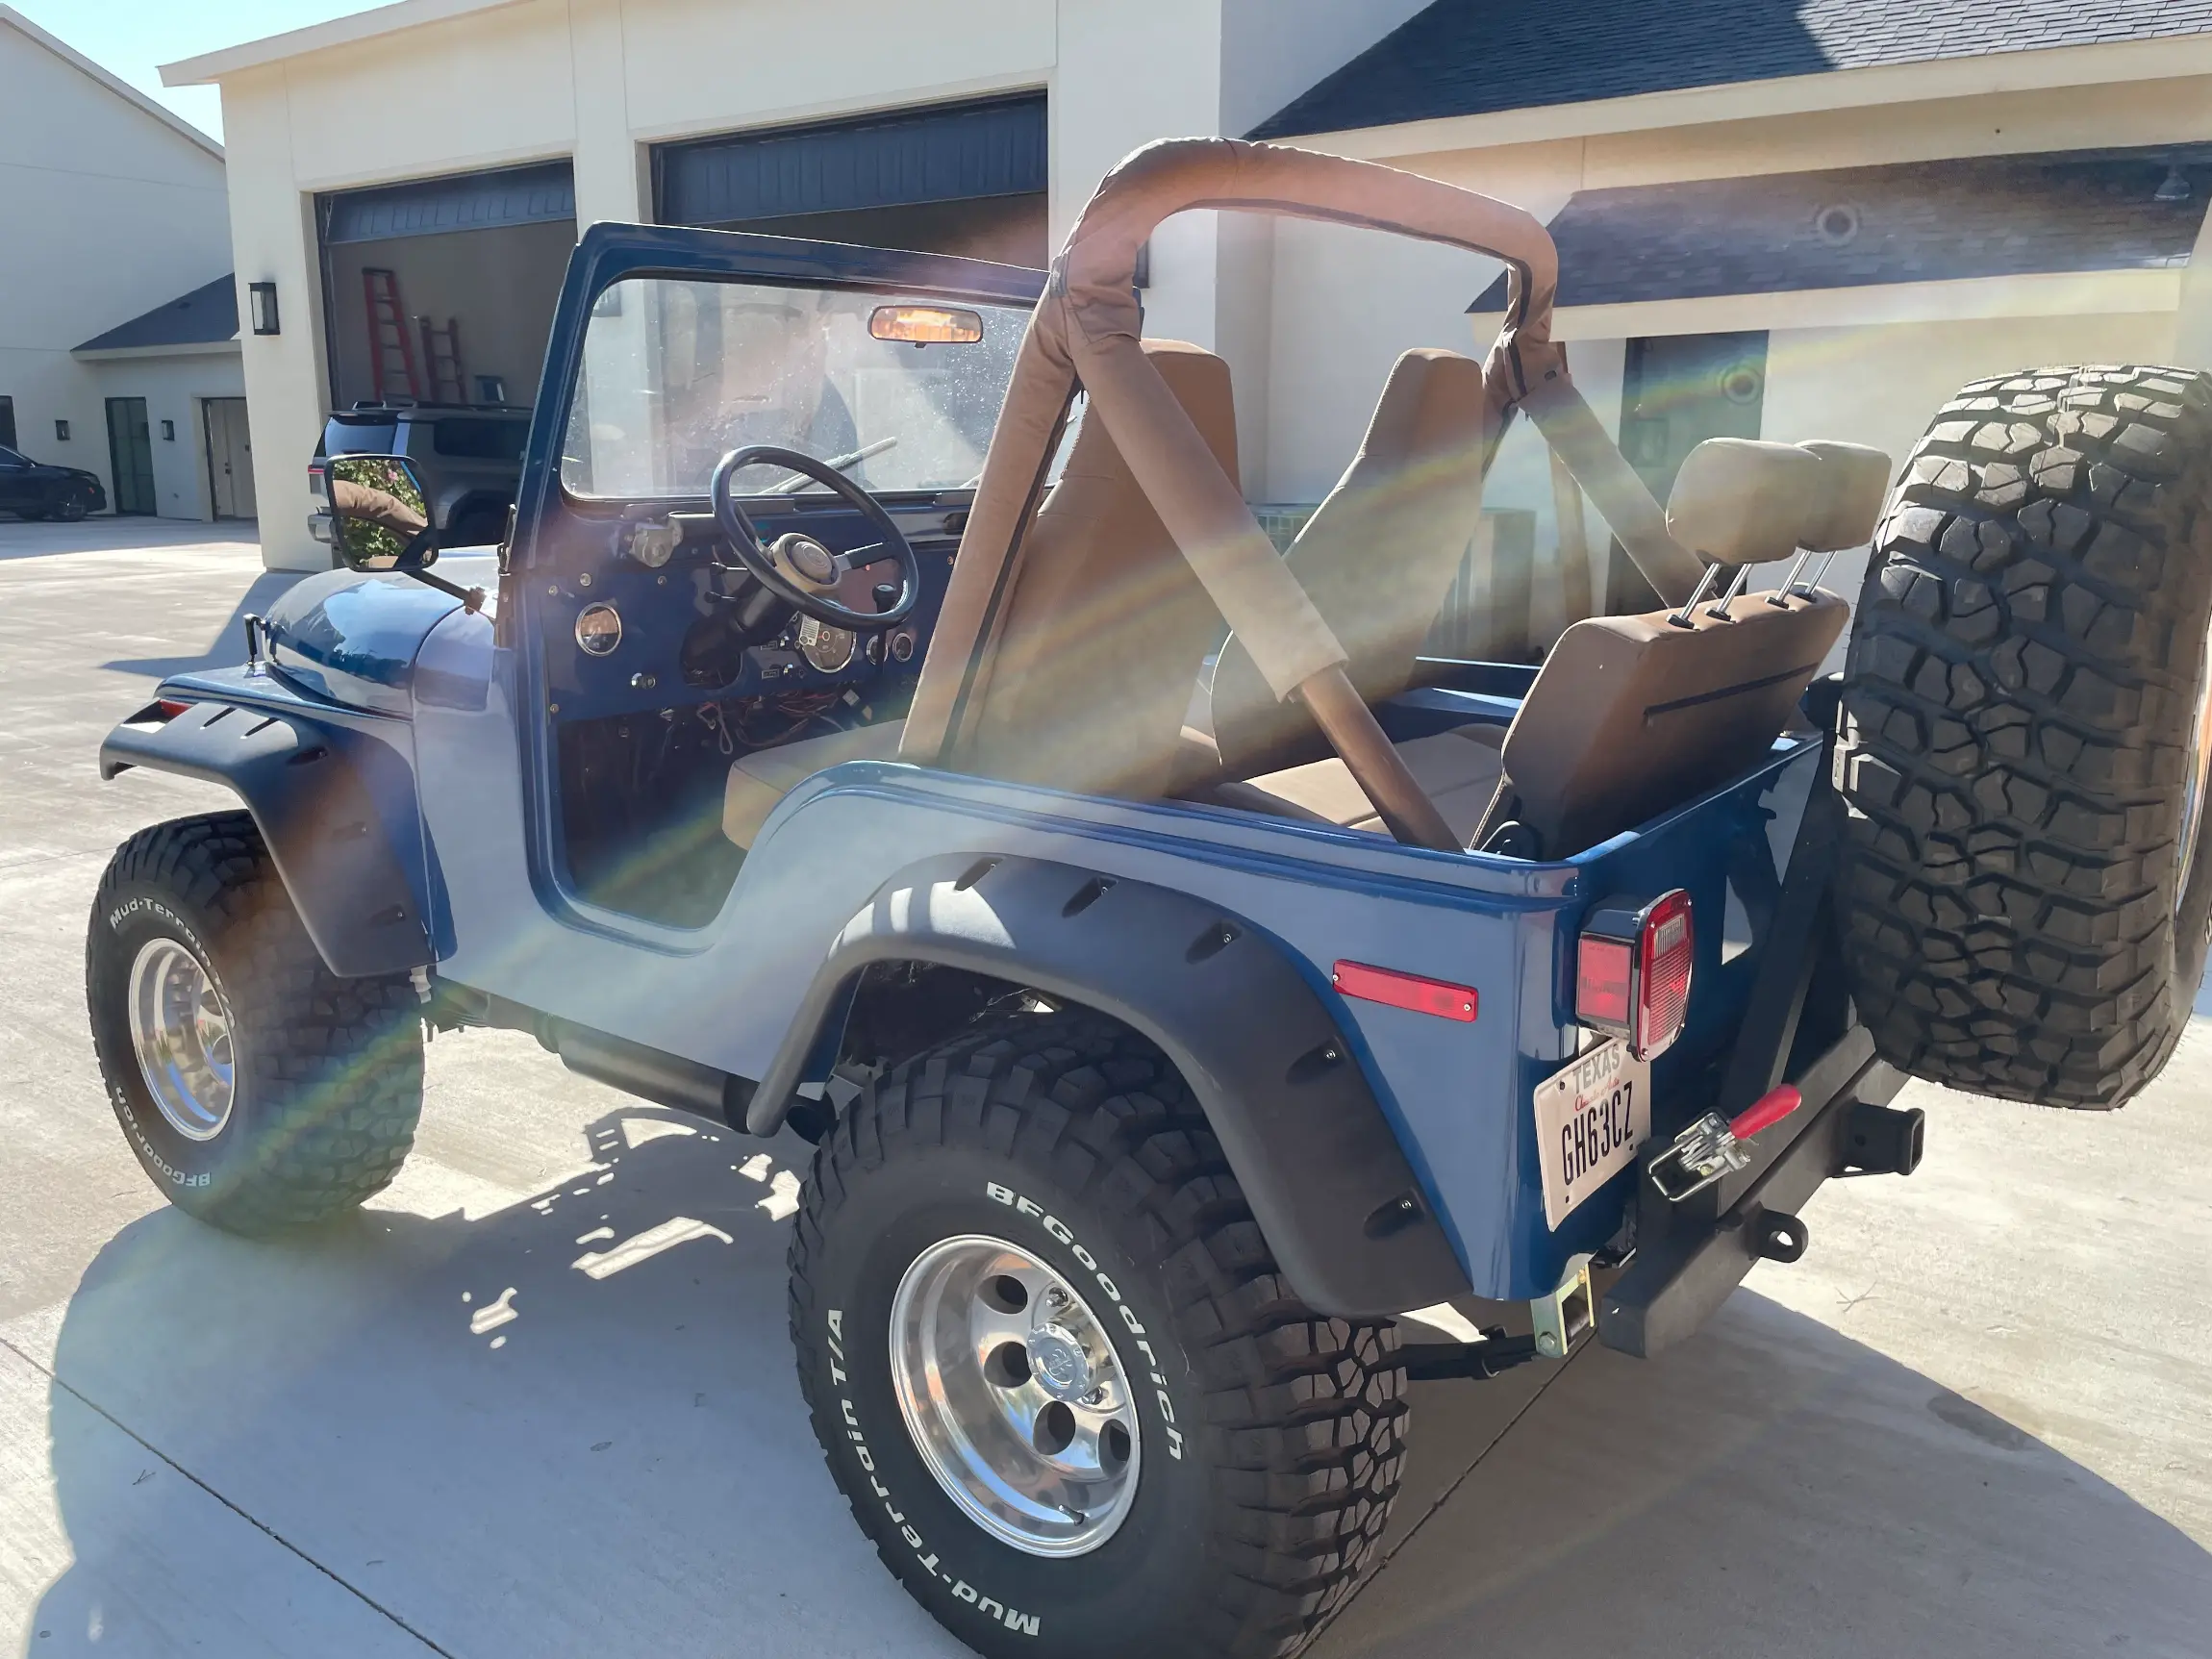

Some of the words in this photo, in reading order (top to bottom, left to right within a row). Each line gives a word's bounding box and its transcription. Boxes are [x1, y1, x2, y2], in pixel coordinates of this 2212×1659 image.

[1572, 1043, 1621, 1094] TEXAS
[115, 1086, 211, 1187] BFGoodrich
[1562, 1080, 1634, 1186] GH63CZ
[827, 1309, 847, 1386] T/A
[986, 1181, 1184, 1460] BFGoodrich
[841, 1398, 1041, 1636] Mud-Terrain
